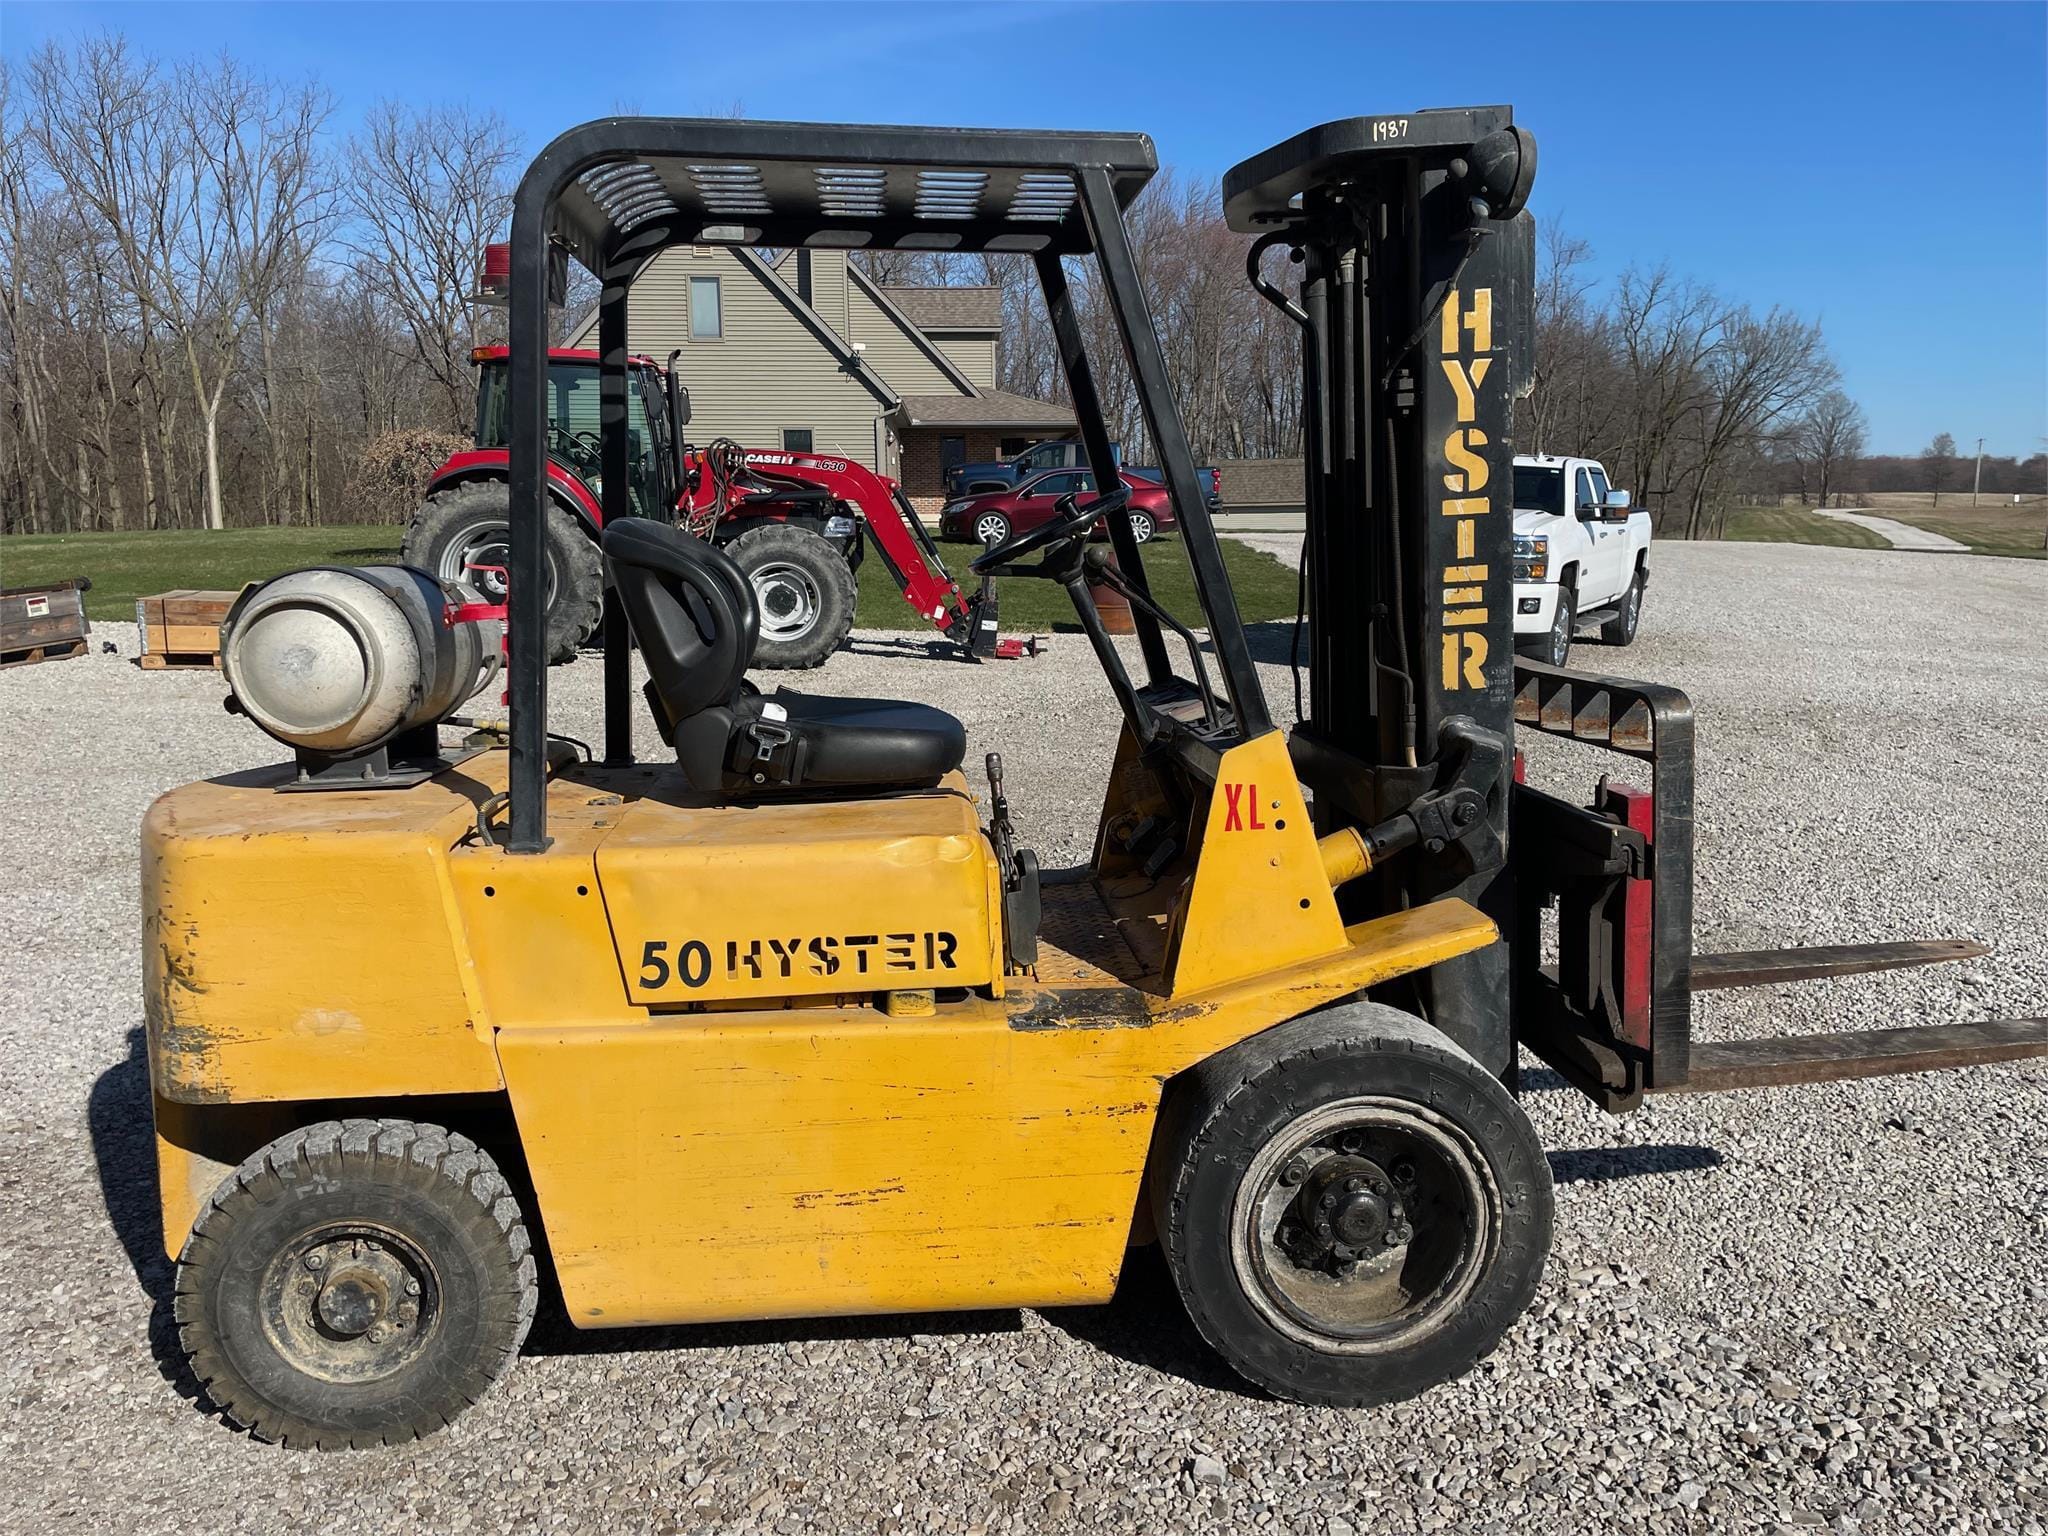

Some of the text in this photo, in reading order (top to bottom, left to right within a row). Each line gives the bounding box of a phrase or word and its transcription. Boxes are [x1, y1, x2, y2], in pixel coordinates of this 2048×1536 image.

[1373, 120, 1408, 142] 1987
[815, 460, 846, 472] L630
[1441, 287, 1493, 691] HYSTER
[1224, 783, 1266, 832] XL
[639, 931, 958, 989] 50 HYSTER
